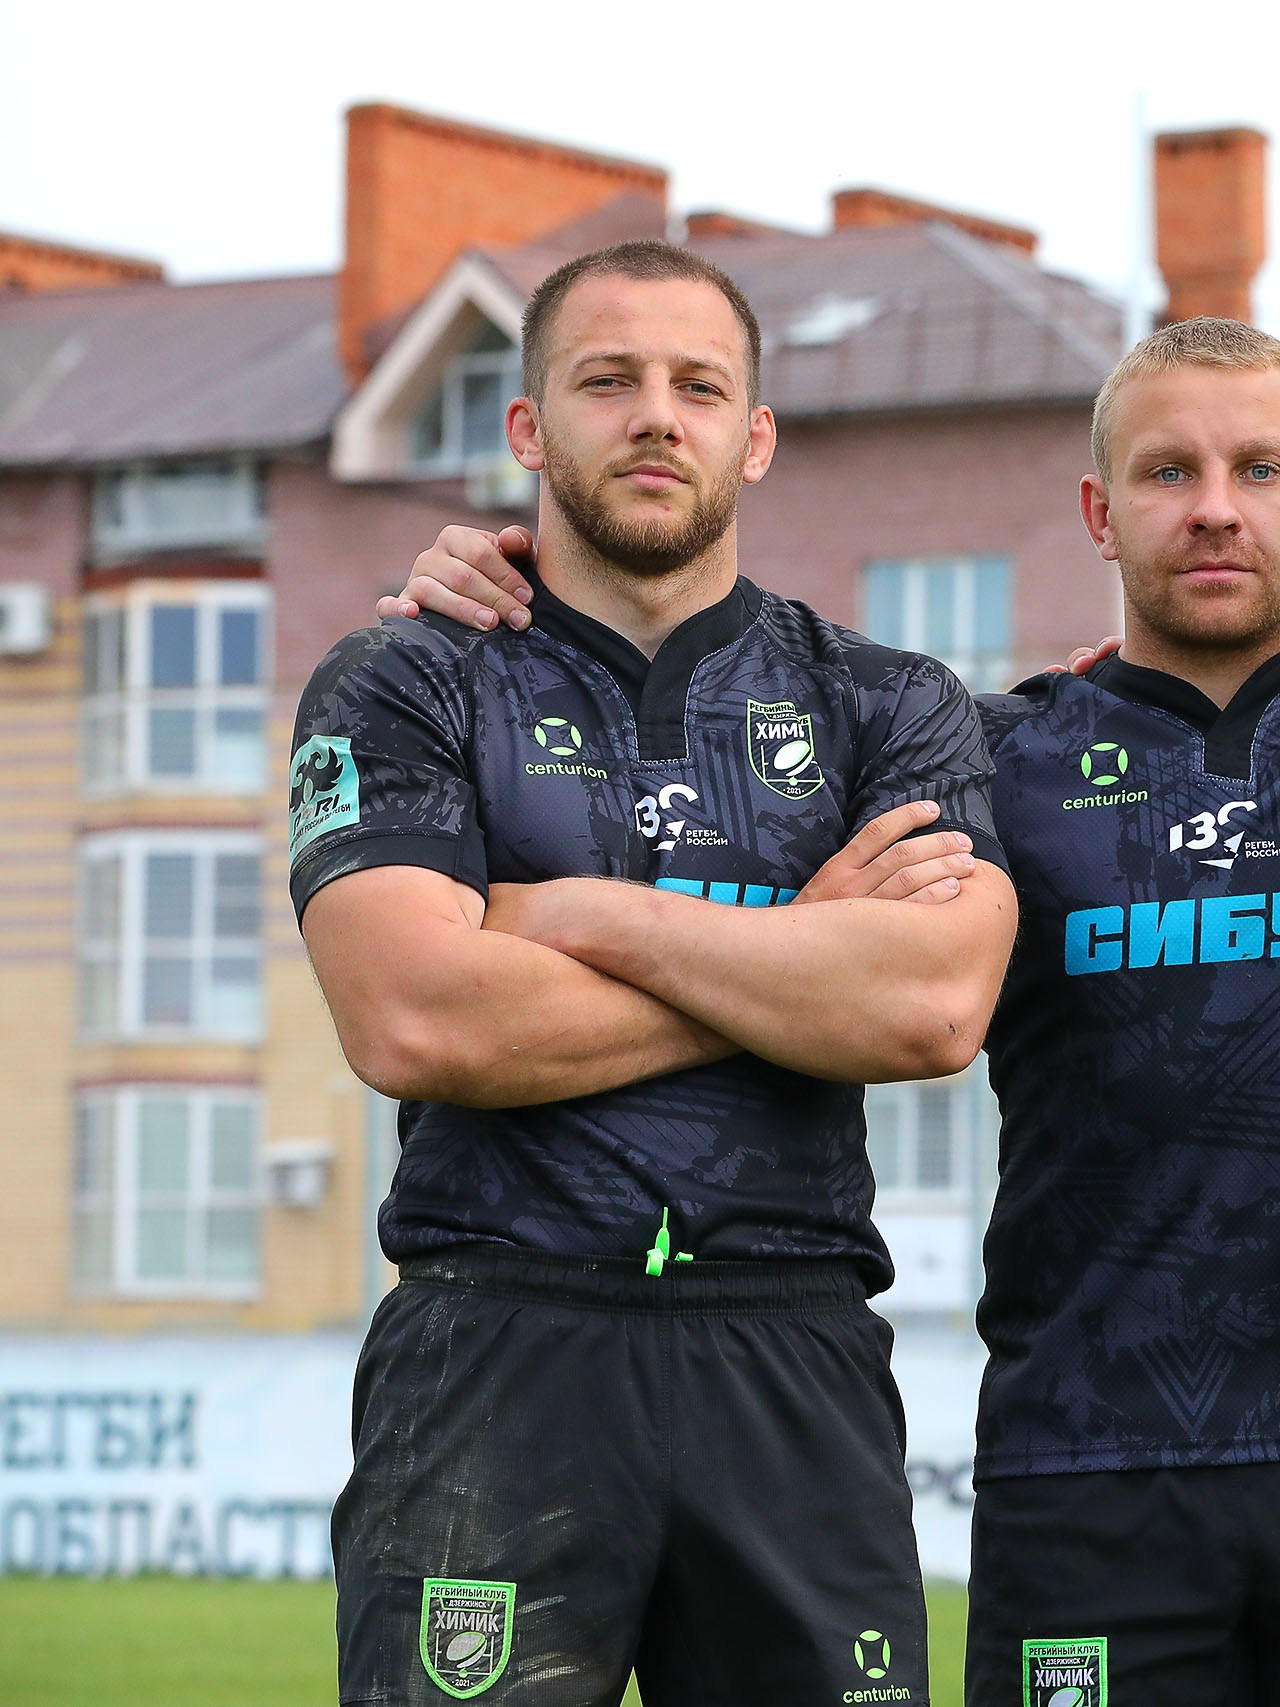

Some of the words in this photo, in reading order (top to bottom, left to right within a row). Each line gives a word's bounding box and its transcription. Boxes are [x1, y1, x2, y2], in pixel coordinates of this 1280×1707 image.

[525, 762, 608, 779] centurion
[787, 786, 802, 794] 2021
[1062, 789, 1148, 810] centurion
[686, 829, 718, 838] РЕГБИ
[686, 837, 728, 846] РОССИИ
[1245, 840, 1276, 850] РЕГБИ
[0, 1391, 200, 1470] ЕГБИ
[0, 1498, 332, 1576] ОБЛАСТ
[430, 1586, 483, 1598] РЕГБИЙНЫЙ
[484, 1589, 507, 1600] КЛУБ
[448, 1599, 487, 1608] ДЗЕРЖИНСК
[434, 1610, 499, 1633] ХИМИК
[1029, 1645, 1076, 1656] РЕГБИЙНЫЙ
[1077, 1645, 1100, 1655] КЛУБ
[1045, 1657, 1081, 1665] ДЗЕРЖИНСК
[455, 1679, 470, 1687] 2021
[1034, 1667, 1095, 1688] ХИМИК
[842, 1684, 911, 1704] centurion
